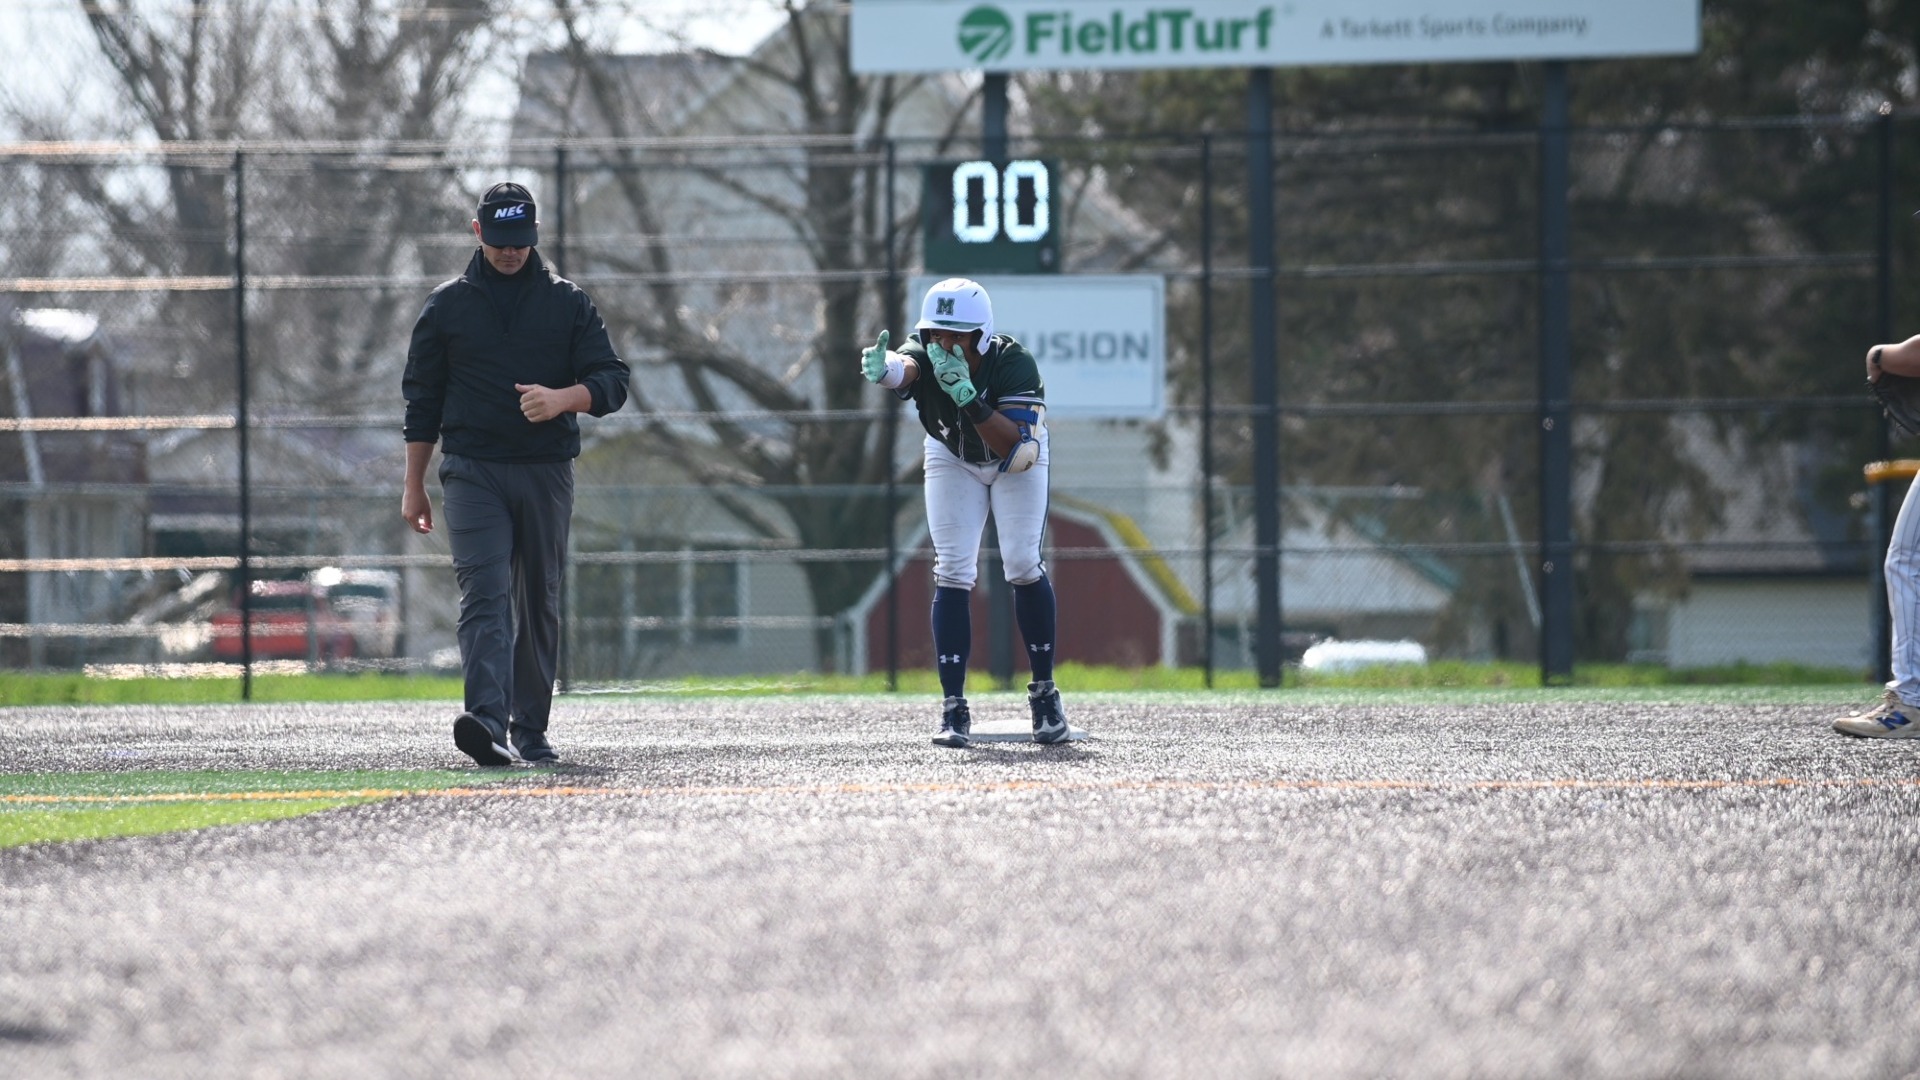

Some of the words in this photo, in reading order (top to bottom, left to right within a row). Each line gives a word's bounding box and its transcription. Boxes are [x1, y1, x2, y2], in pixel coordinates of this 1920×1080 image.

[1024, 7, 1275, 55] FieldTurf
[1318, 17, 1335, 40] A
[1418, 13, 1487, 41] Sports
[1491, 11, 1589, 39] Company
[493, 203, 525, 219] NEC
[953, 160, 1049, 243] 00
[935, 297, 956, 317] M
